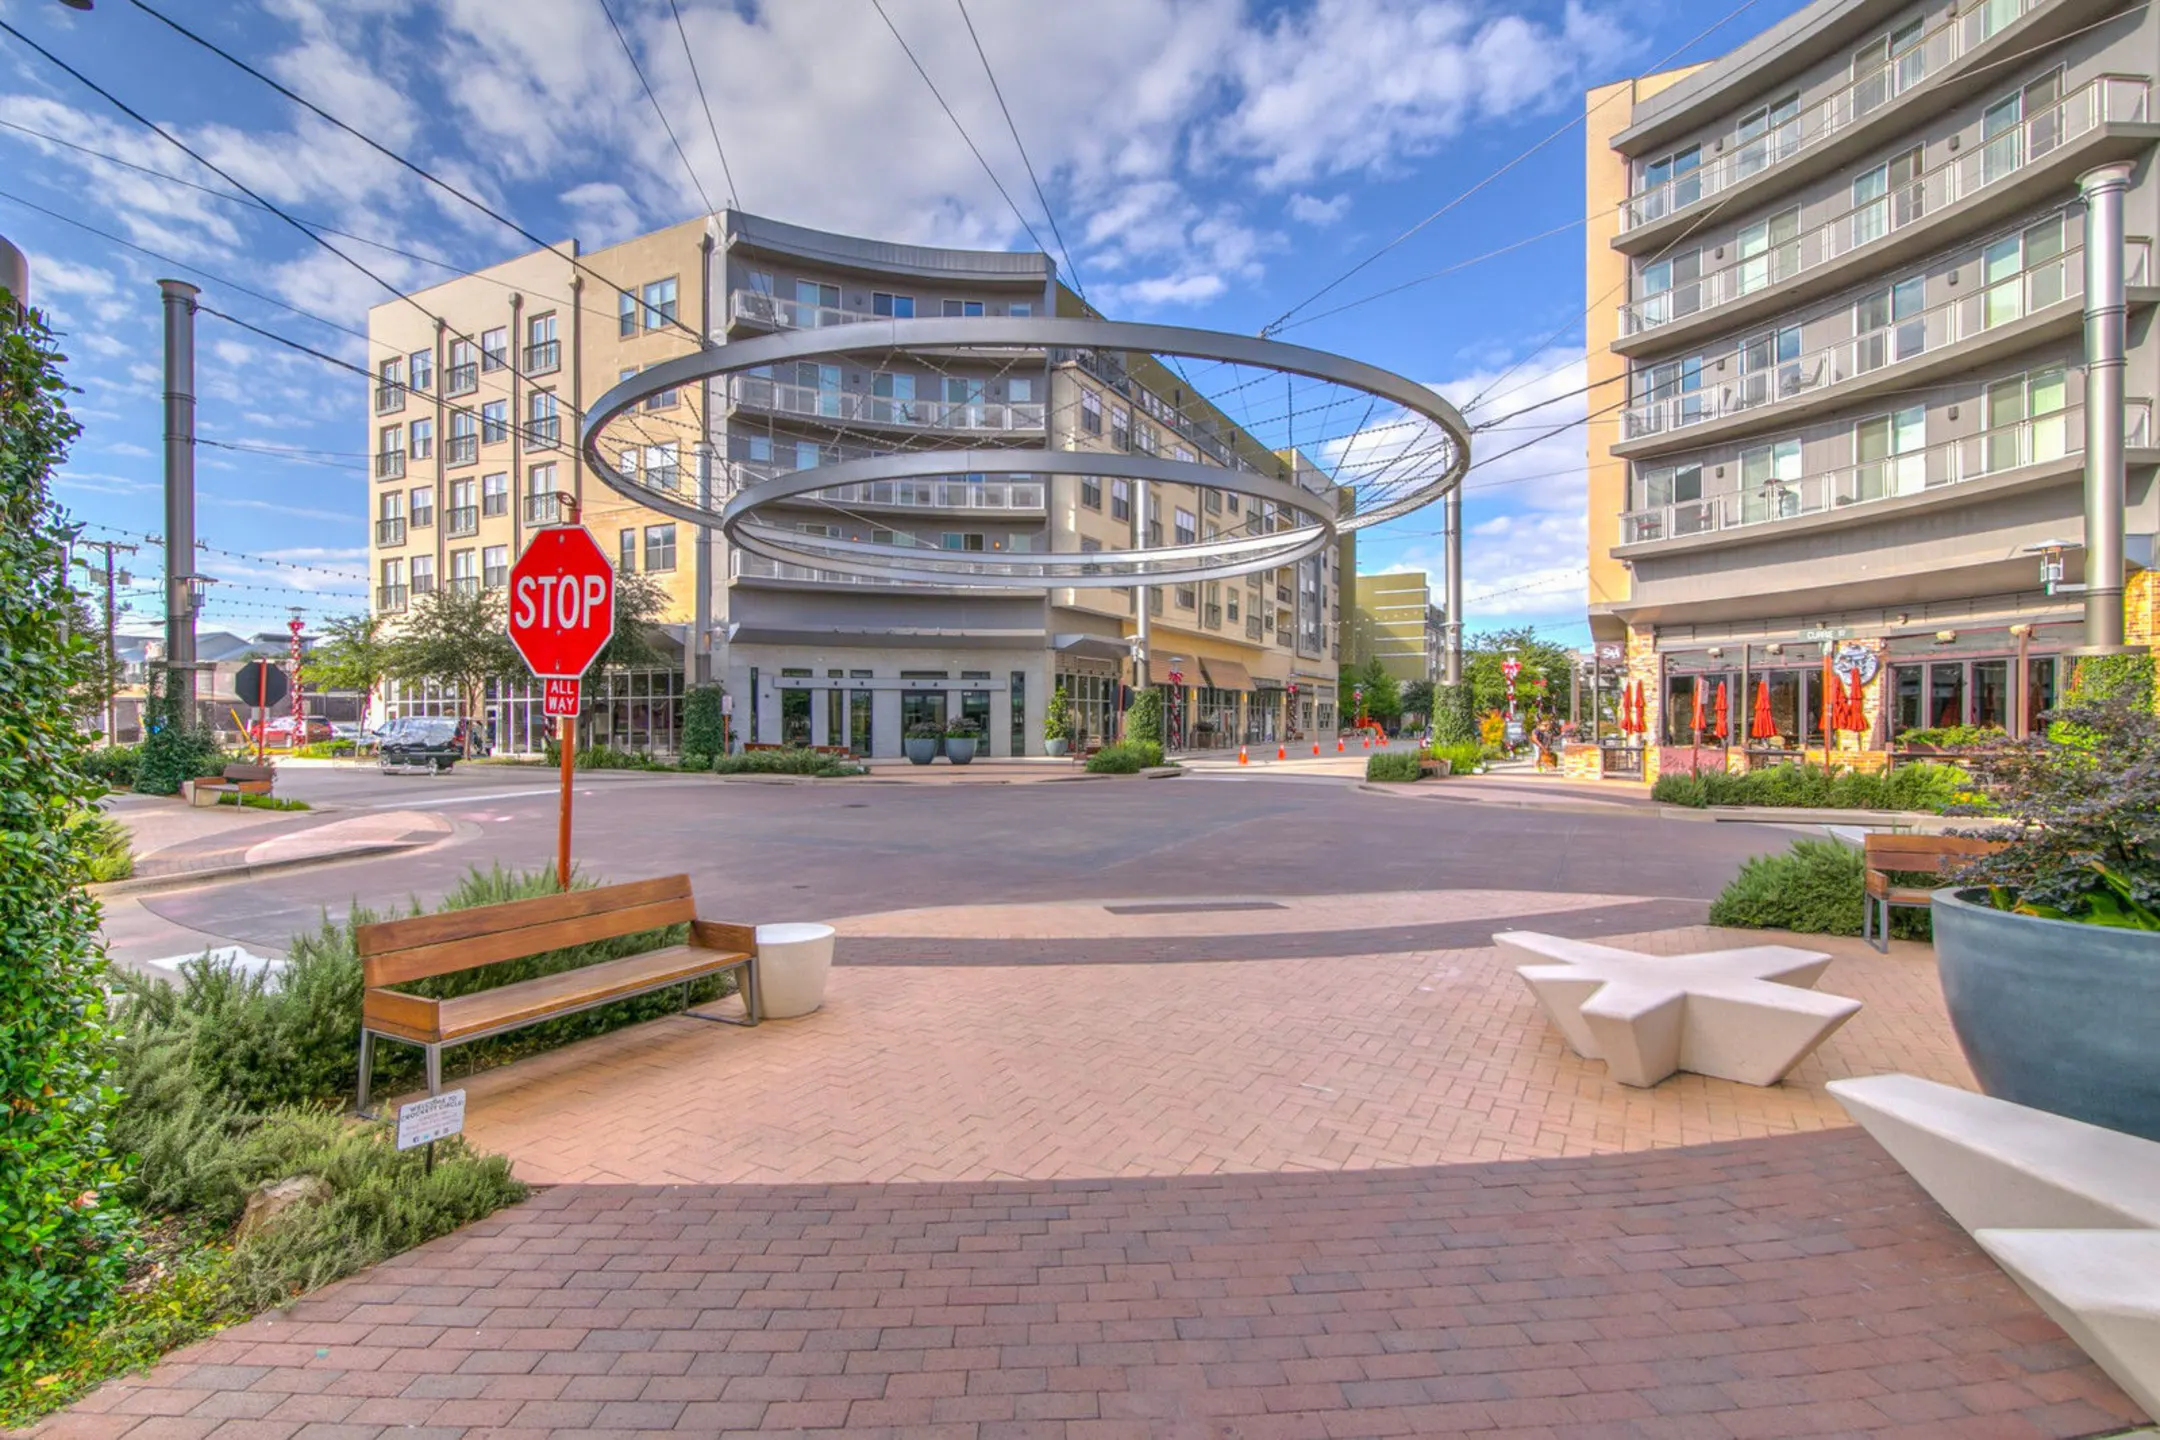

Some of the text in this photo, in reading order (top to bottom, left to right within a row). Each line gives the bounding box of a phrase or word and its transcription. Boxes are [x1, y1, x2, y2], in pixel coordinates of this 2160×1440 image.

[514, 575, 606, 629] STOP
[551, 681, 574, 695] ALL
[548, 696, 575, 711] WAY
